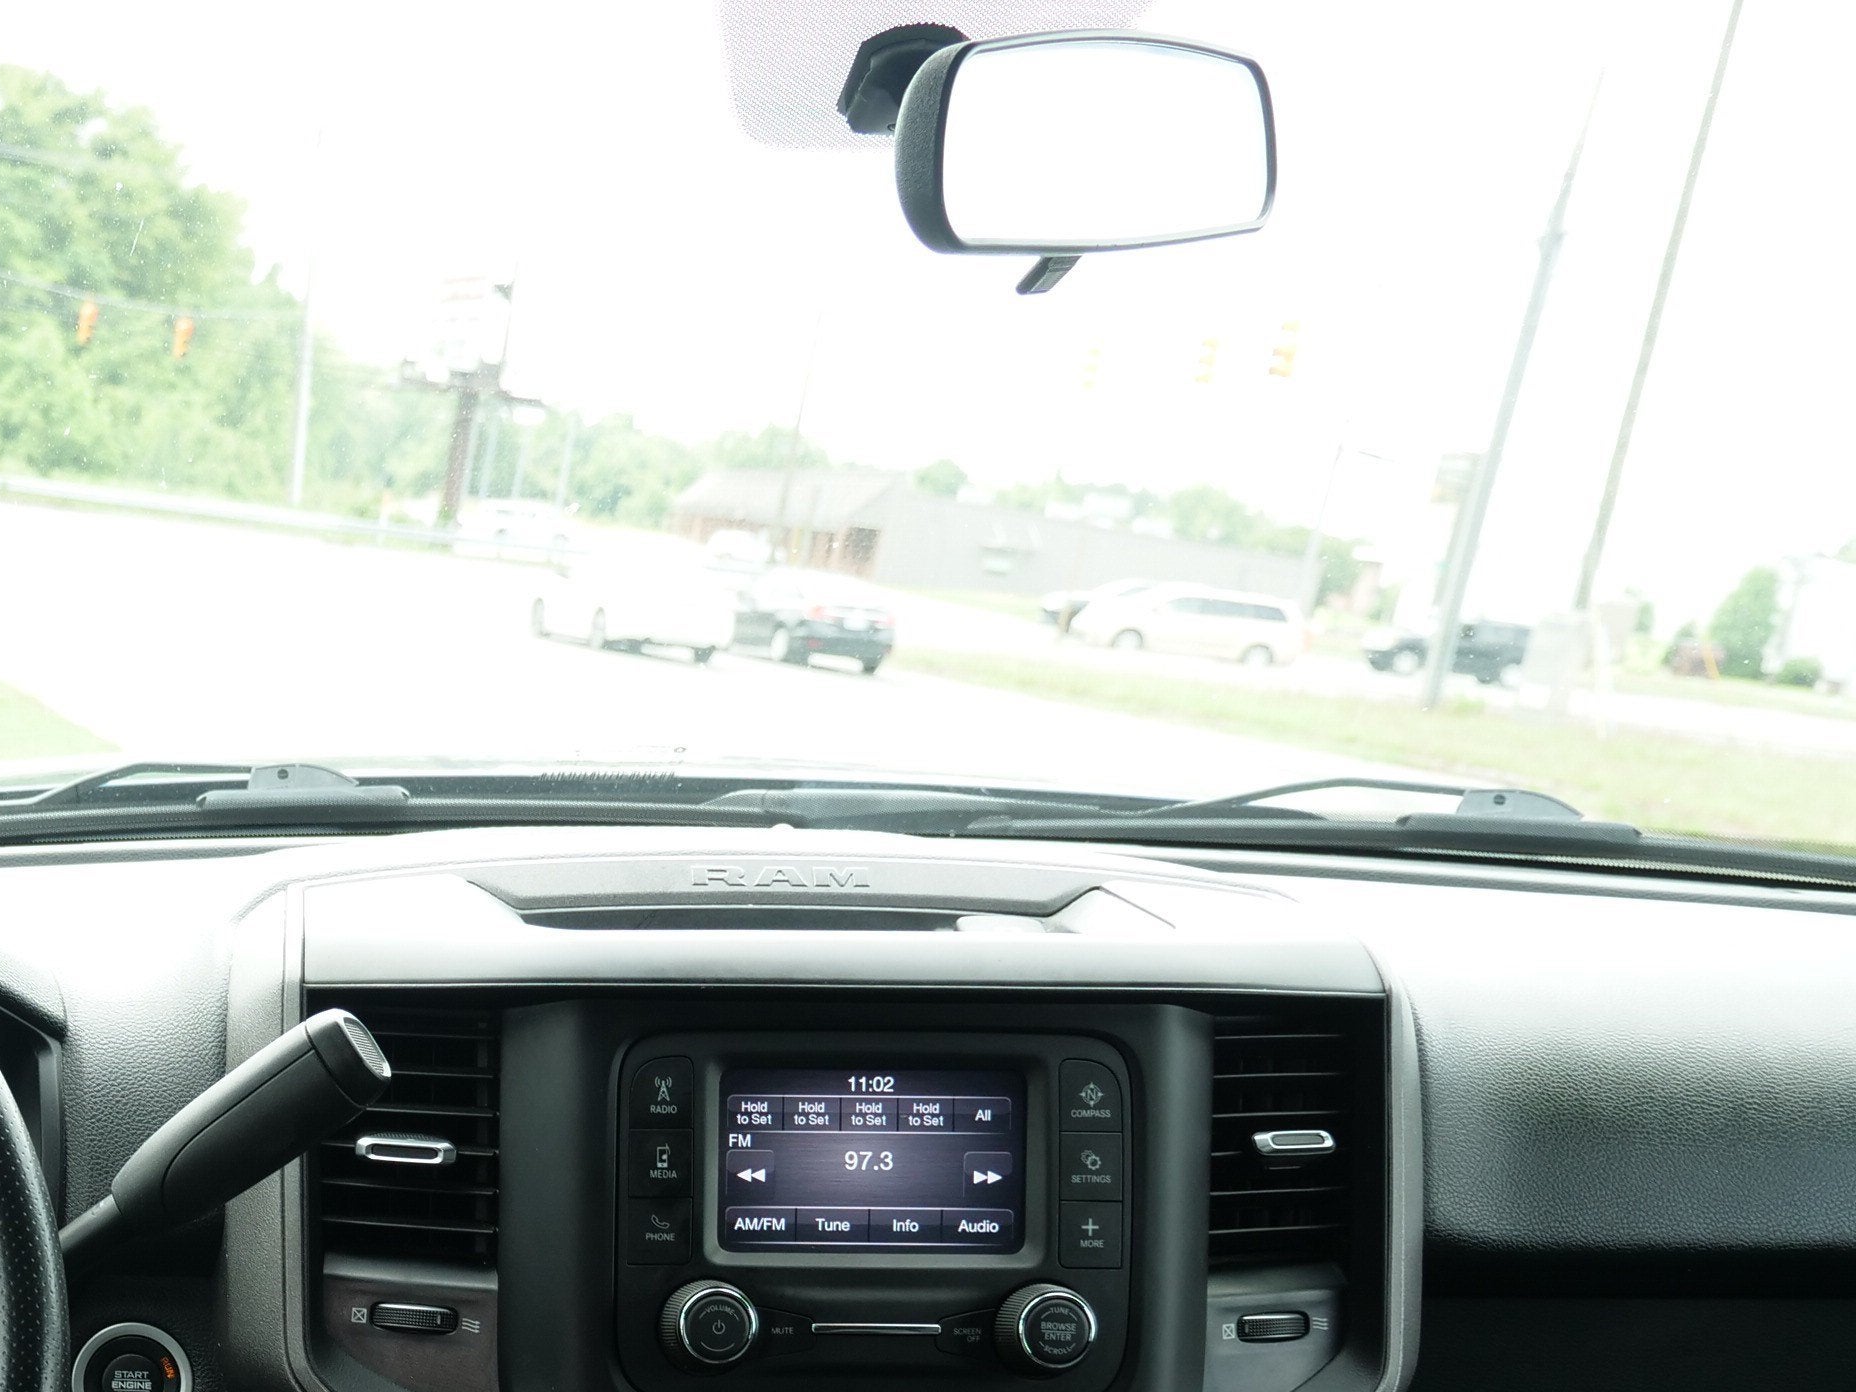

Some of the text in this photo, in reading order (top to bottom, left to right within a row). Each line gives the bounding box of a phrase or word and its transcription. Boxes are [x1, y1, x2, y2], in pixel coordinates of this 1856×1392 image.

[691, 864, 871, 890] RAM
[848, 1076, 894, 1092] 11:02
[650, 1105, 678, 1114] RADIO
[741, 1101, 768, 1113] Hold
[798, 1101, 825, 1113] Hold
[856, 1102, 882, 1114] Hold
[913, 1102, 940, 1114] Hold
[975, 1109, 991, 1122] All
[1071, 1109, 1111, 1118] COMPASS
[737, 1114, 772, 1125] to Set
[794, 1114, 829, 1125] to Set
[851, 1115, 886, 1126] to Set
[908, 1115, 944, 1126] to Set
[728, 1134, 751, 1148] FM
[844, 1151, 894, 1171] 97.3
[650, 1170, 677, 1179] MEDIA
[1071, 1175, 1111, 1183] SETTINGS
[734, 1217, 786, 1231] AM/FM
[815, 1218, 851, 1232] Tune
[892, 1219, 919, 1233] Info
[958, 1219, 999, 1233] Audio
[646, 1233, 676, 1241] PHONE
[1080, 1239, 1104, 1248] MORE
[705, 1304, 735, 1315] VOLUME
[1050, 1307, 1070, 1315] TUNE
[771, 1326, 794, 1335] MUTE
[953, 1327, 981, 1335] SCREEN
[1041, 1321, 1077, 1331] BROWSE
[1044, 1332, 1072, 1341] ENTER
[114, 1370, 149, 1379] START
[111, 1381, 152, 1390] ENGINE
